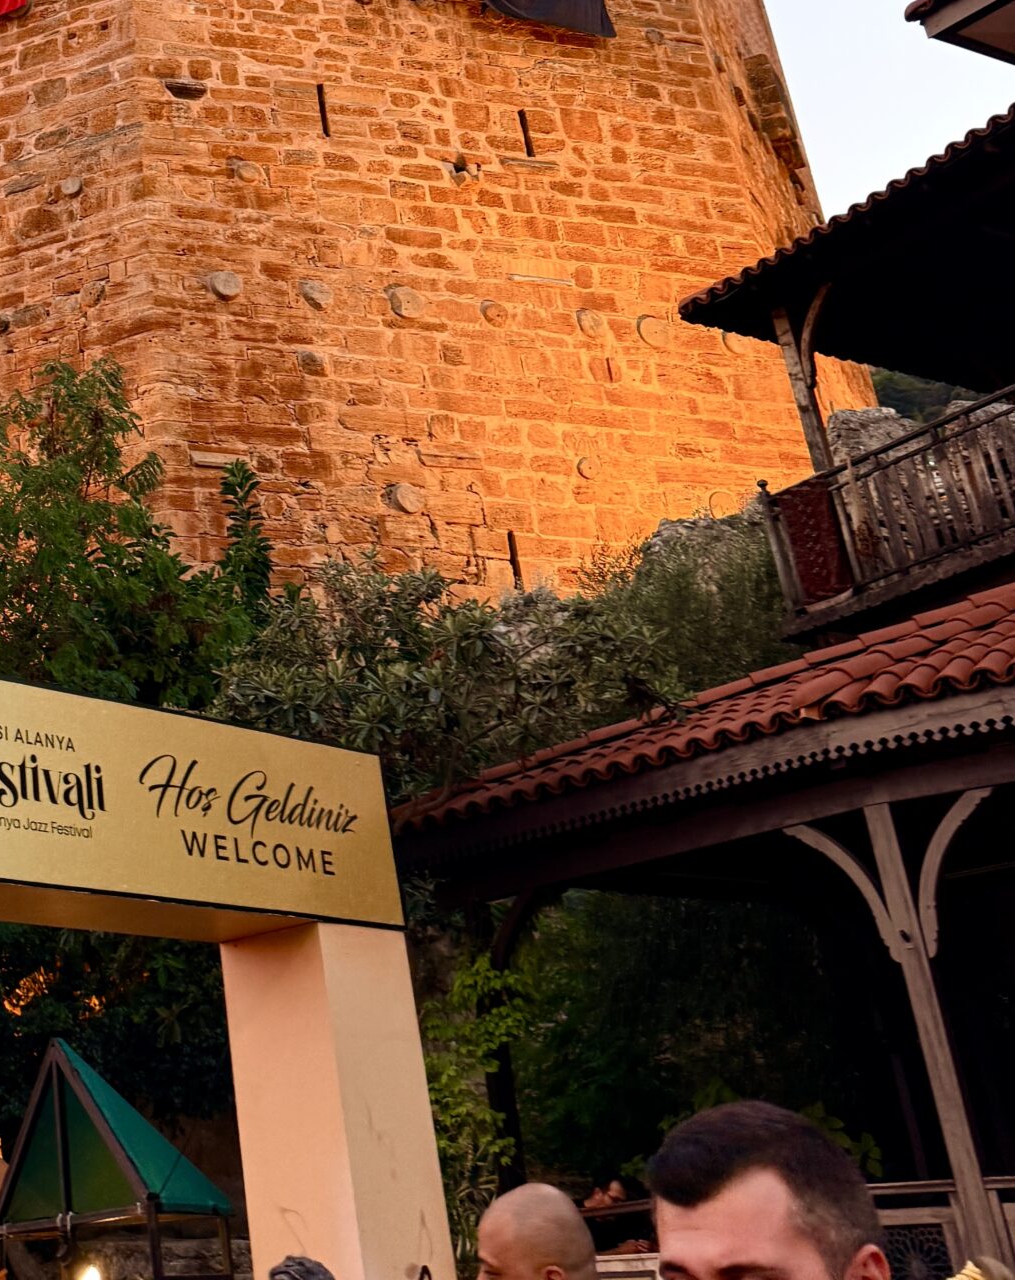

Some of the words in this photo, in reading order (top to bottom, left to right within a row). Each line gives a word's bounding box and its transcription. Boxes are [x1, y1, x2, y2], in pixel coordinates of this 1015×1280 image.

[14, 728, 76, 753] ALANYA
[139, 754, 221, 818] Hoş
[227, 770, 359, 839] Geldiniz
[23, 817, 49, 834] Jazz
[51, 821, 93, 839] Festival
[181, 829, 336, 876] WELCOME
